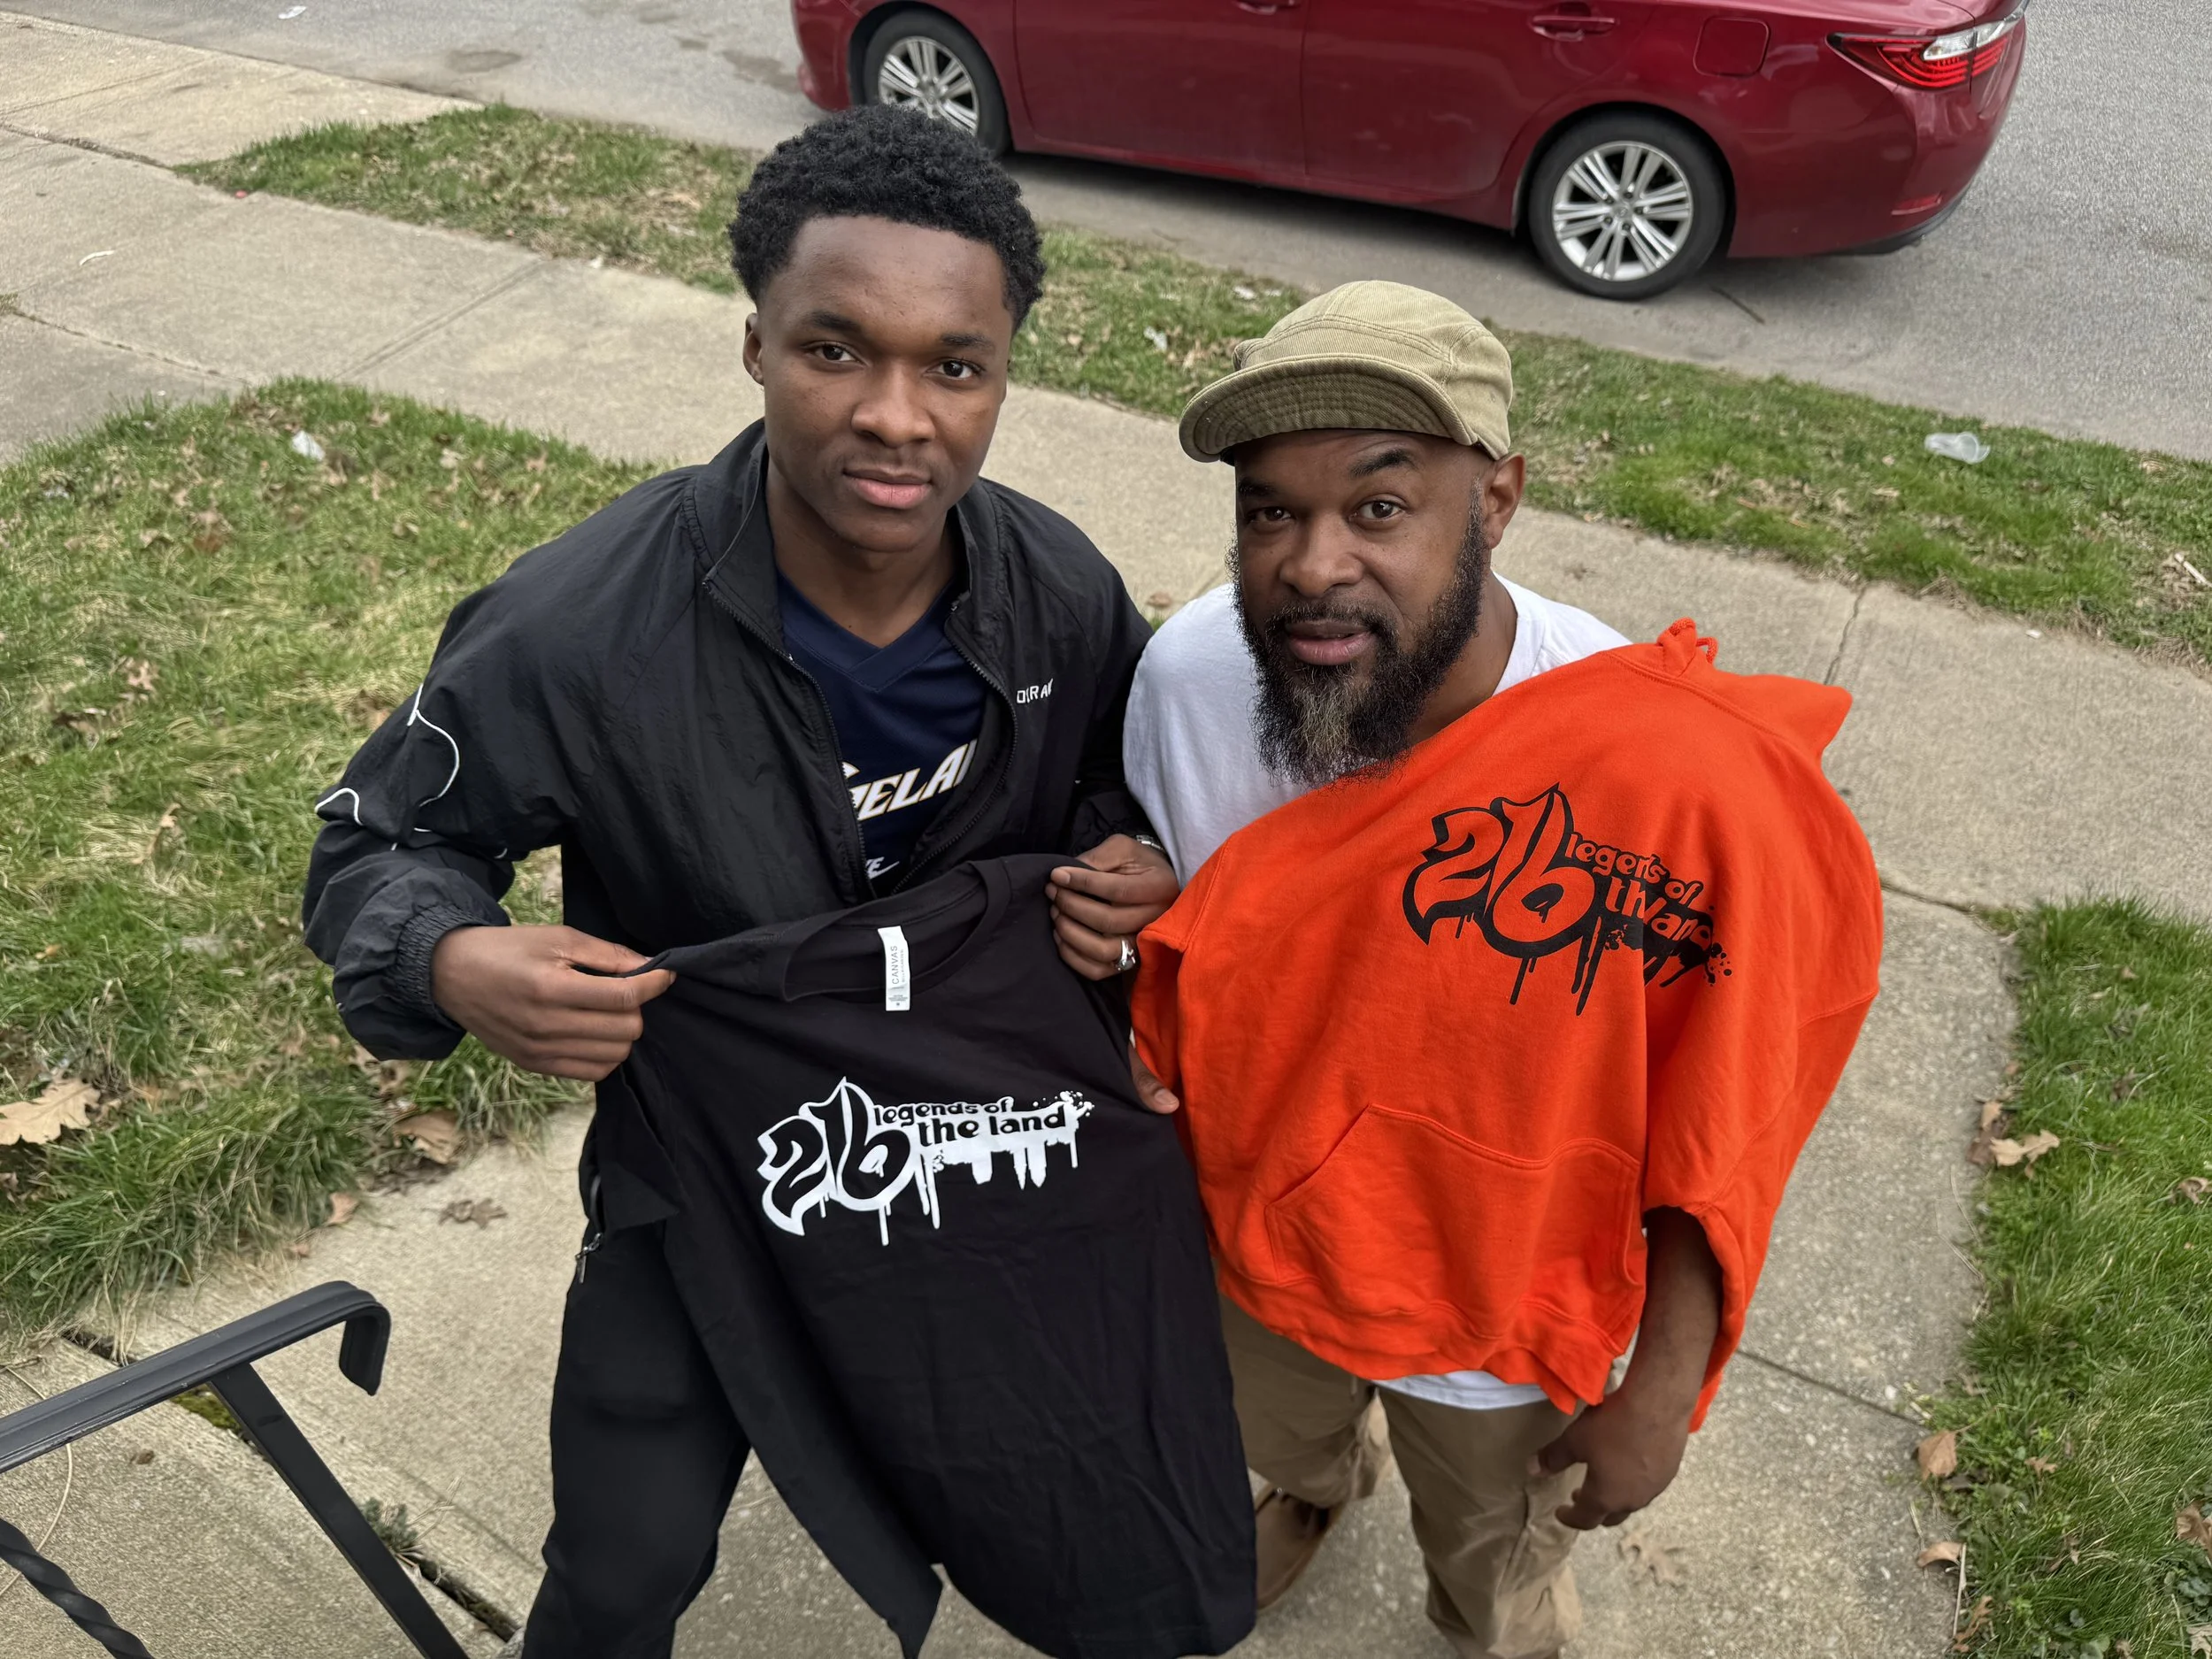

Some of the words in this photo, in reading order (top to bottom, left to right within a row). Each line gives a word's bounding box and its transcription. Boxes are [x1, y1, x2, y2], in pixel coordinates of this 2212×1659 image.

[844, 738, 977, 821] ELA
[890, 945, 900, 984] CANVAS
[874, 1102, 979, 1128] legends
[984, 1098, 1011, 1113] of
[918, 1118, 979, 1147] the
[989, 1104, 1065, 1135] land
